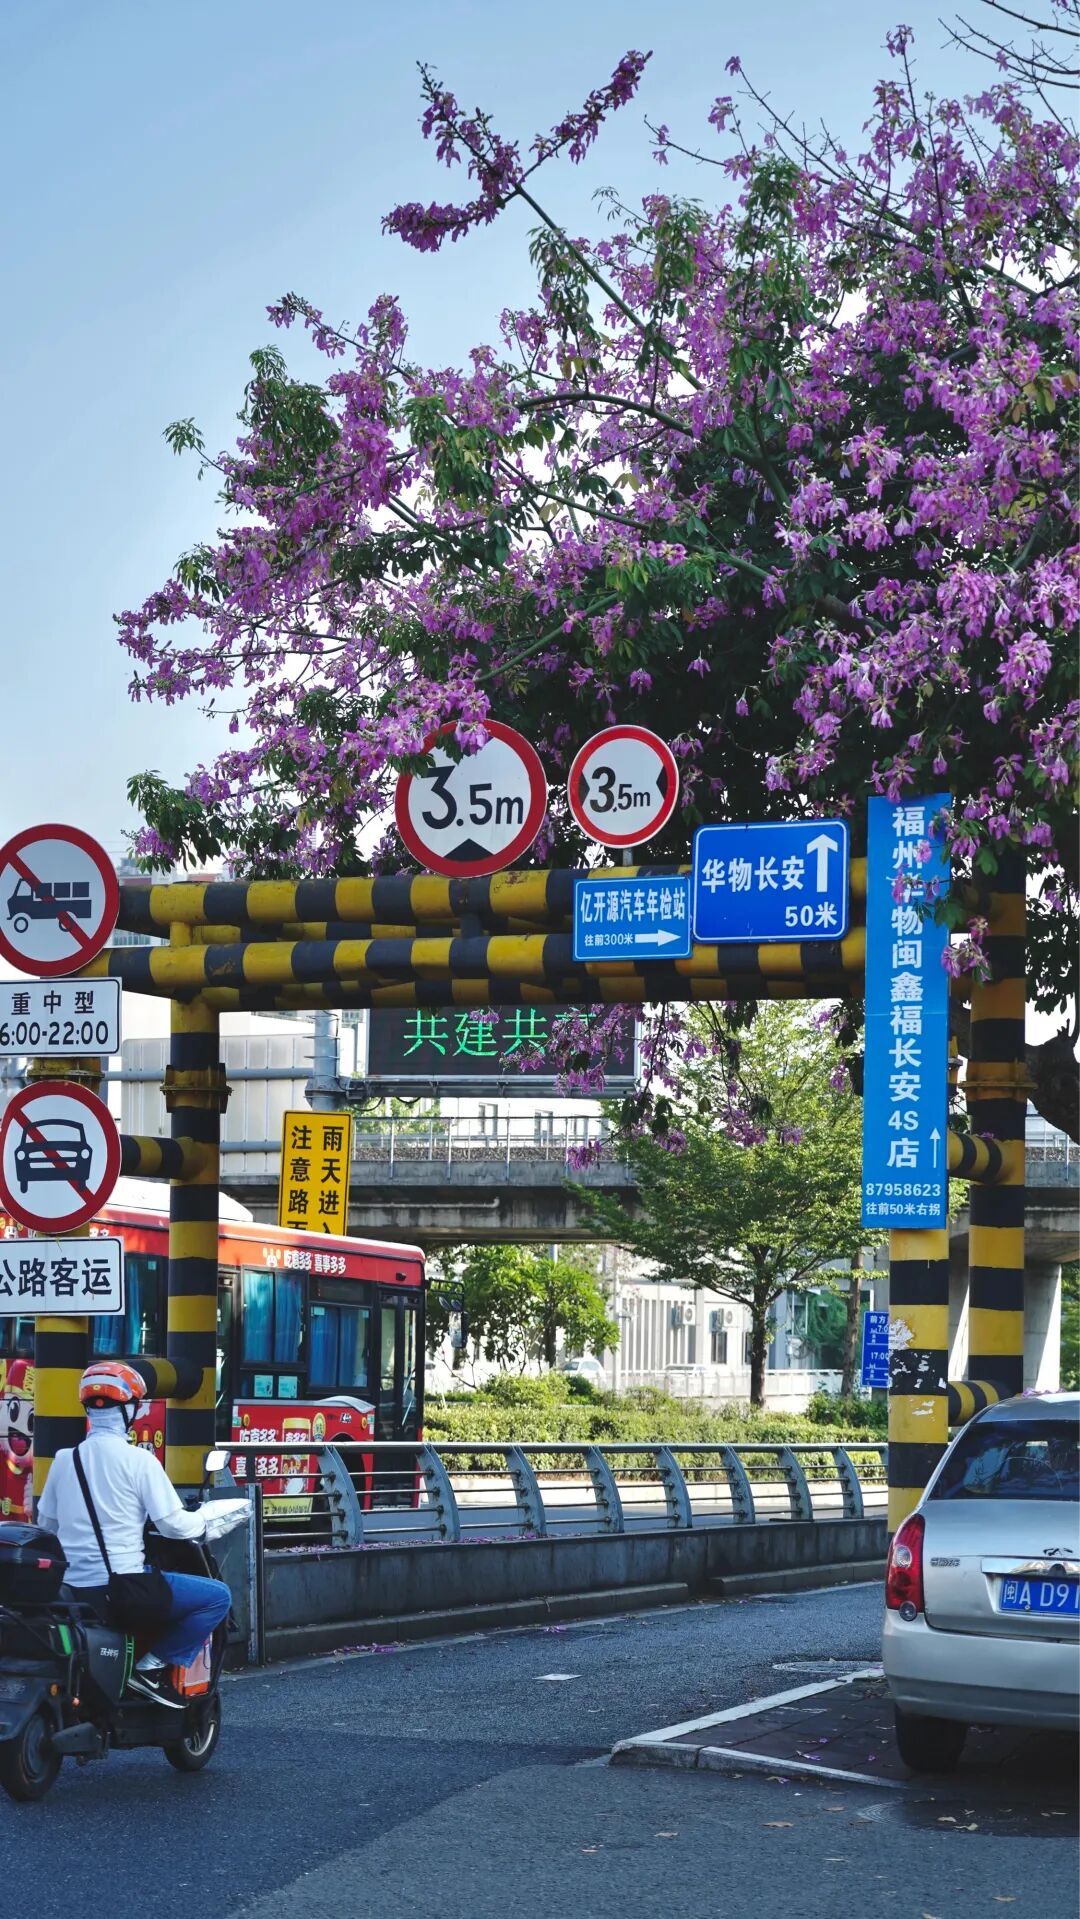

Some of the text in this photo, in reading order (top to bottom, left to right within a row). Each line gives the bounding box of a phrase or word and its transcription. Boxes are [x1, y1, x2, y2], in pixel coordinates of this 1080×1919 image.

[421, 765, 525, 830] 3.5m
[589, 766, 651, 813] 3.5m
[701, 855, 806, 894] 华物长安
[580, 886, 687, 924] 亿开源汽车年检站
[784, 902, 838, 928] 50米
[584, 934, 634, 947] 往前300米
[11, 990, 95, 1015] 重中型
[403, 1008, 597, 1056] 共建共
[865, 1183, 941, 1197] 87958623
[865, 1202, 941, 1215] 往前50米右拐
[314, 1253, 346, 1274] 喜事多多
[0, 1257, 112, 1297] 公路客运
[235, 1456, 279, 1477] 喜多多
